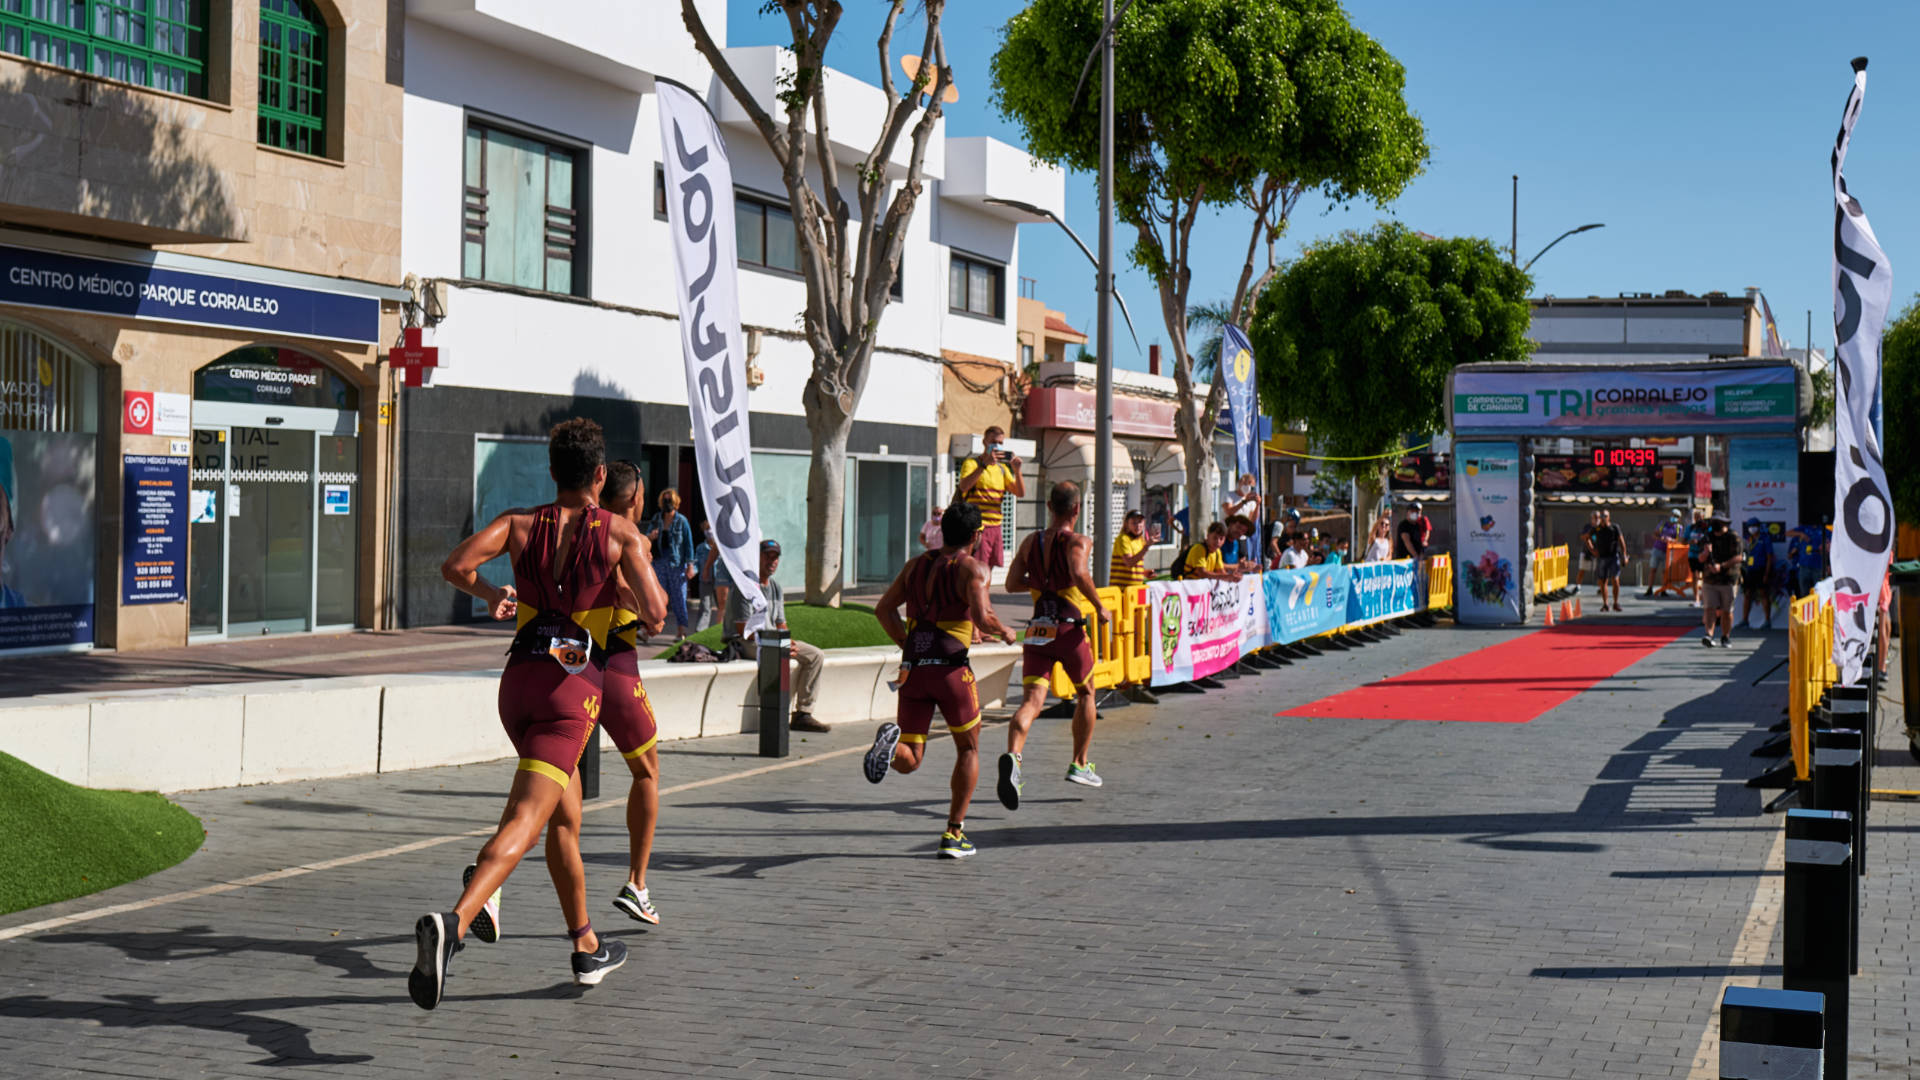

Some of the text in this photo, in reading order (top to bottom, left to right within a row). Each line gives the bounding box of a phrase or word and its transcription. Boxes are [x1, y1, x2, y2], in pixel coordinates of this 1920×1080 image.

[9, 266, 279, 315] CENTRO MÉDICO PARQUE CORRALEJO
[229, 368, 317, 386] CENTRO MÉDICO PARQUE
[256, 384, 292, 394] CORRALEJO
[1467, 403, 1524, 412] DE CANARIAS
[1535, 387, 1708, 417] TRI CORRALEJO
[124, 456, 188, 466] CENTRO MÉDICO PARQUE
